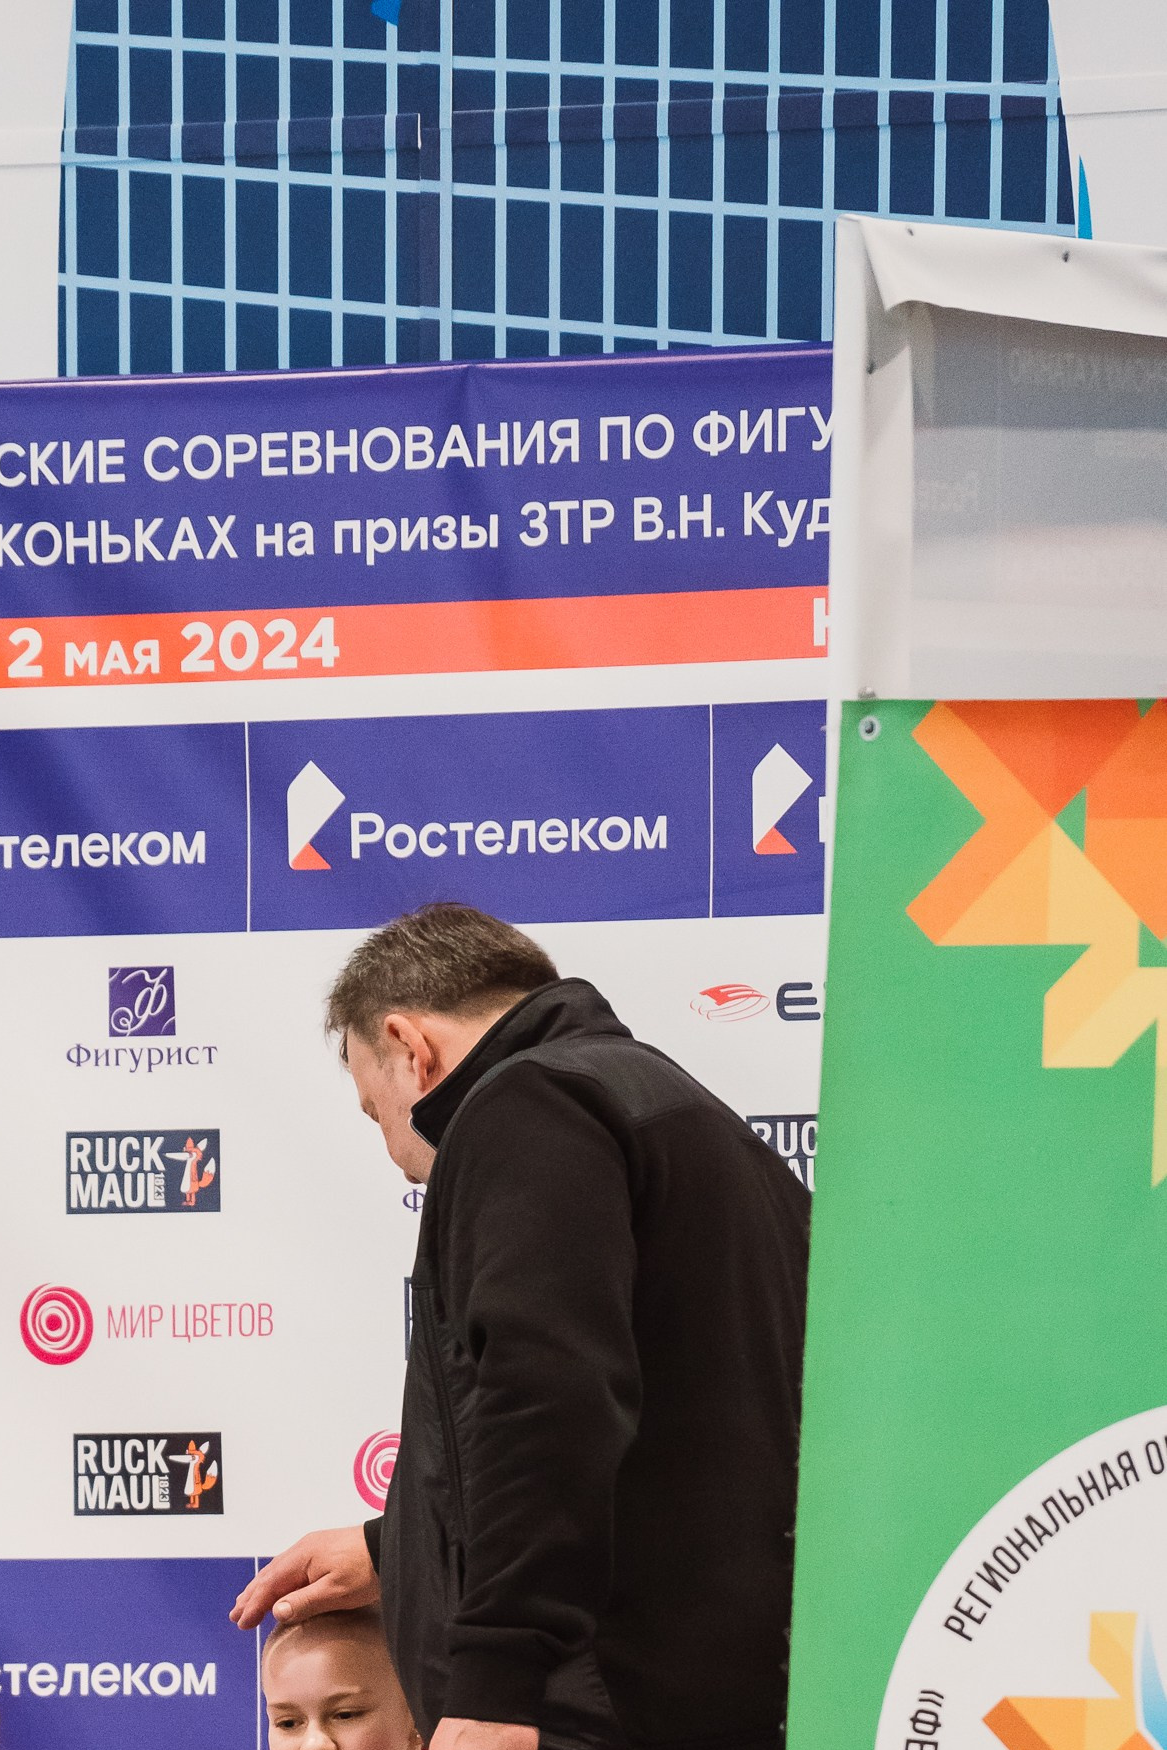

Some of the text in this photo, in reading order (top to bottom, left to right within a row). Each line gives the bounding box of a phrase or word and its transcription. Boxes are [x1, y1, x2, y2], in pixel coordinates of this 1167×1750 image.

[143, 418, 580, 480] СОРЕВНОВАНИЯ
[600, 414, 674, 461] ПО
[693, 406, 833, 455] ФИГУ
[256, 520, 314, 557] на
[334, 512, 498, 565] призы
[520, 501, 614, 547] ЗТР
[634, 495, 725, 541] В.Н.
[8, 628, 42, 678] 2
[64, 640, 159, 677] МАЯ
[180, 617, 340, 673] 2024
[351, 812, 668, 858] Ростелеком
[66, 1042, 218, 1073] Фигурист
[70, 1136, 165, 1173] RUCK
[71, 1173, 165, 1209] MAUL
[107, 1303, 273, 1342] МИР ЦВЕТОВ
[77, 1439, 169, 1475] RUCK
[77, 1475, 170, 1511] MAUL
[944, 1450, 1140, 1641] РЕГИОНАЛЬНАЯ
